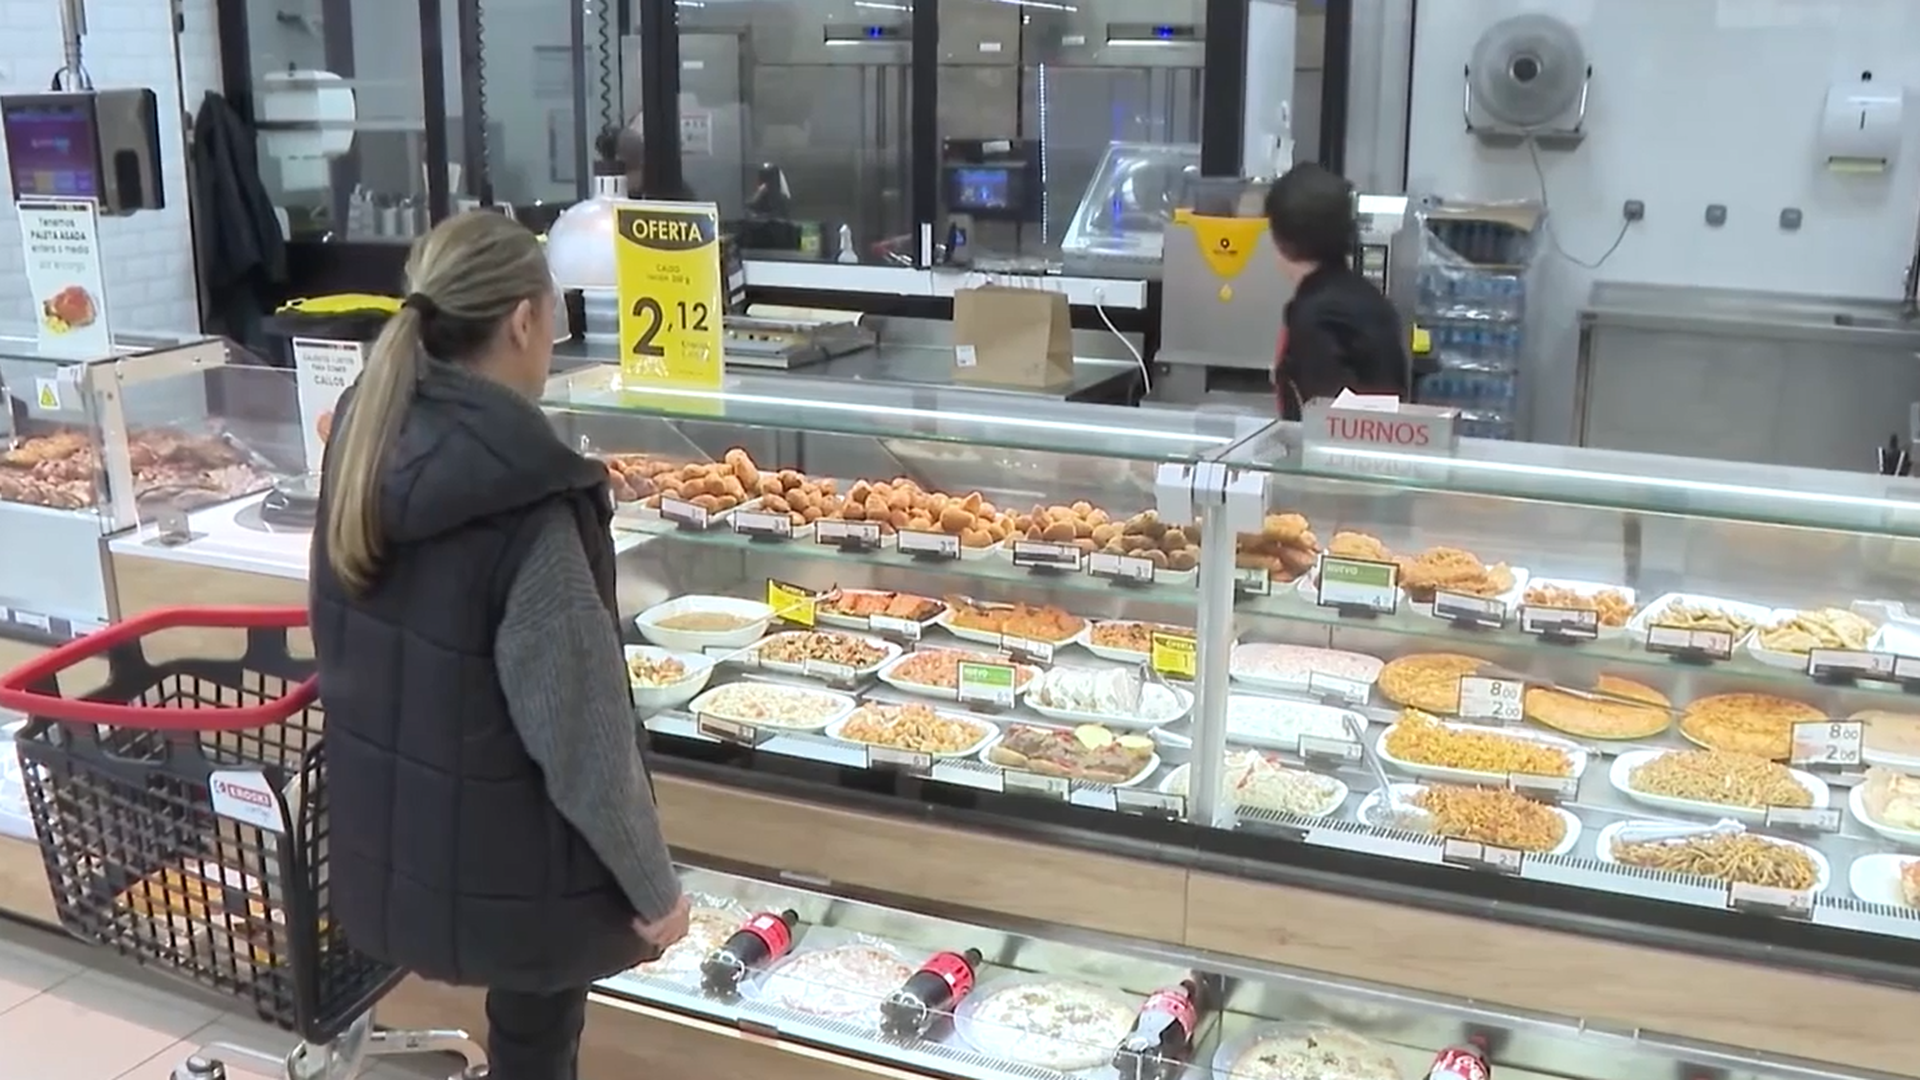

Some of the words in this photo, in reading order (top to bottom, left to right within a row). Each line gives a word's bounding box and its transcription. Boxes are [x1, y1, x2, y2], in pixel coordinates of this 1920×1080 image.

[632, 219, 702, 242] OFERTA
[633, 296, 708, 357] 2,12
[1326, 416, 1429, 446] TURNOS
